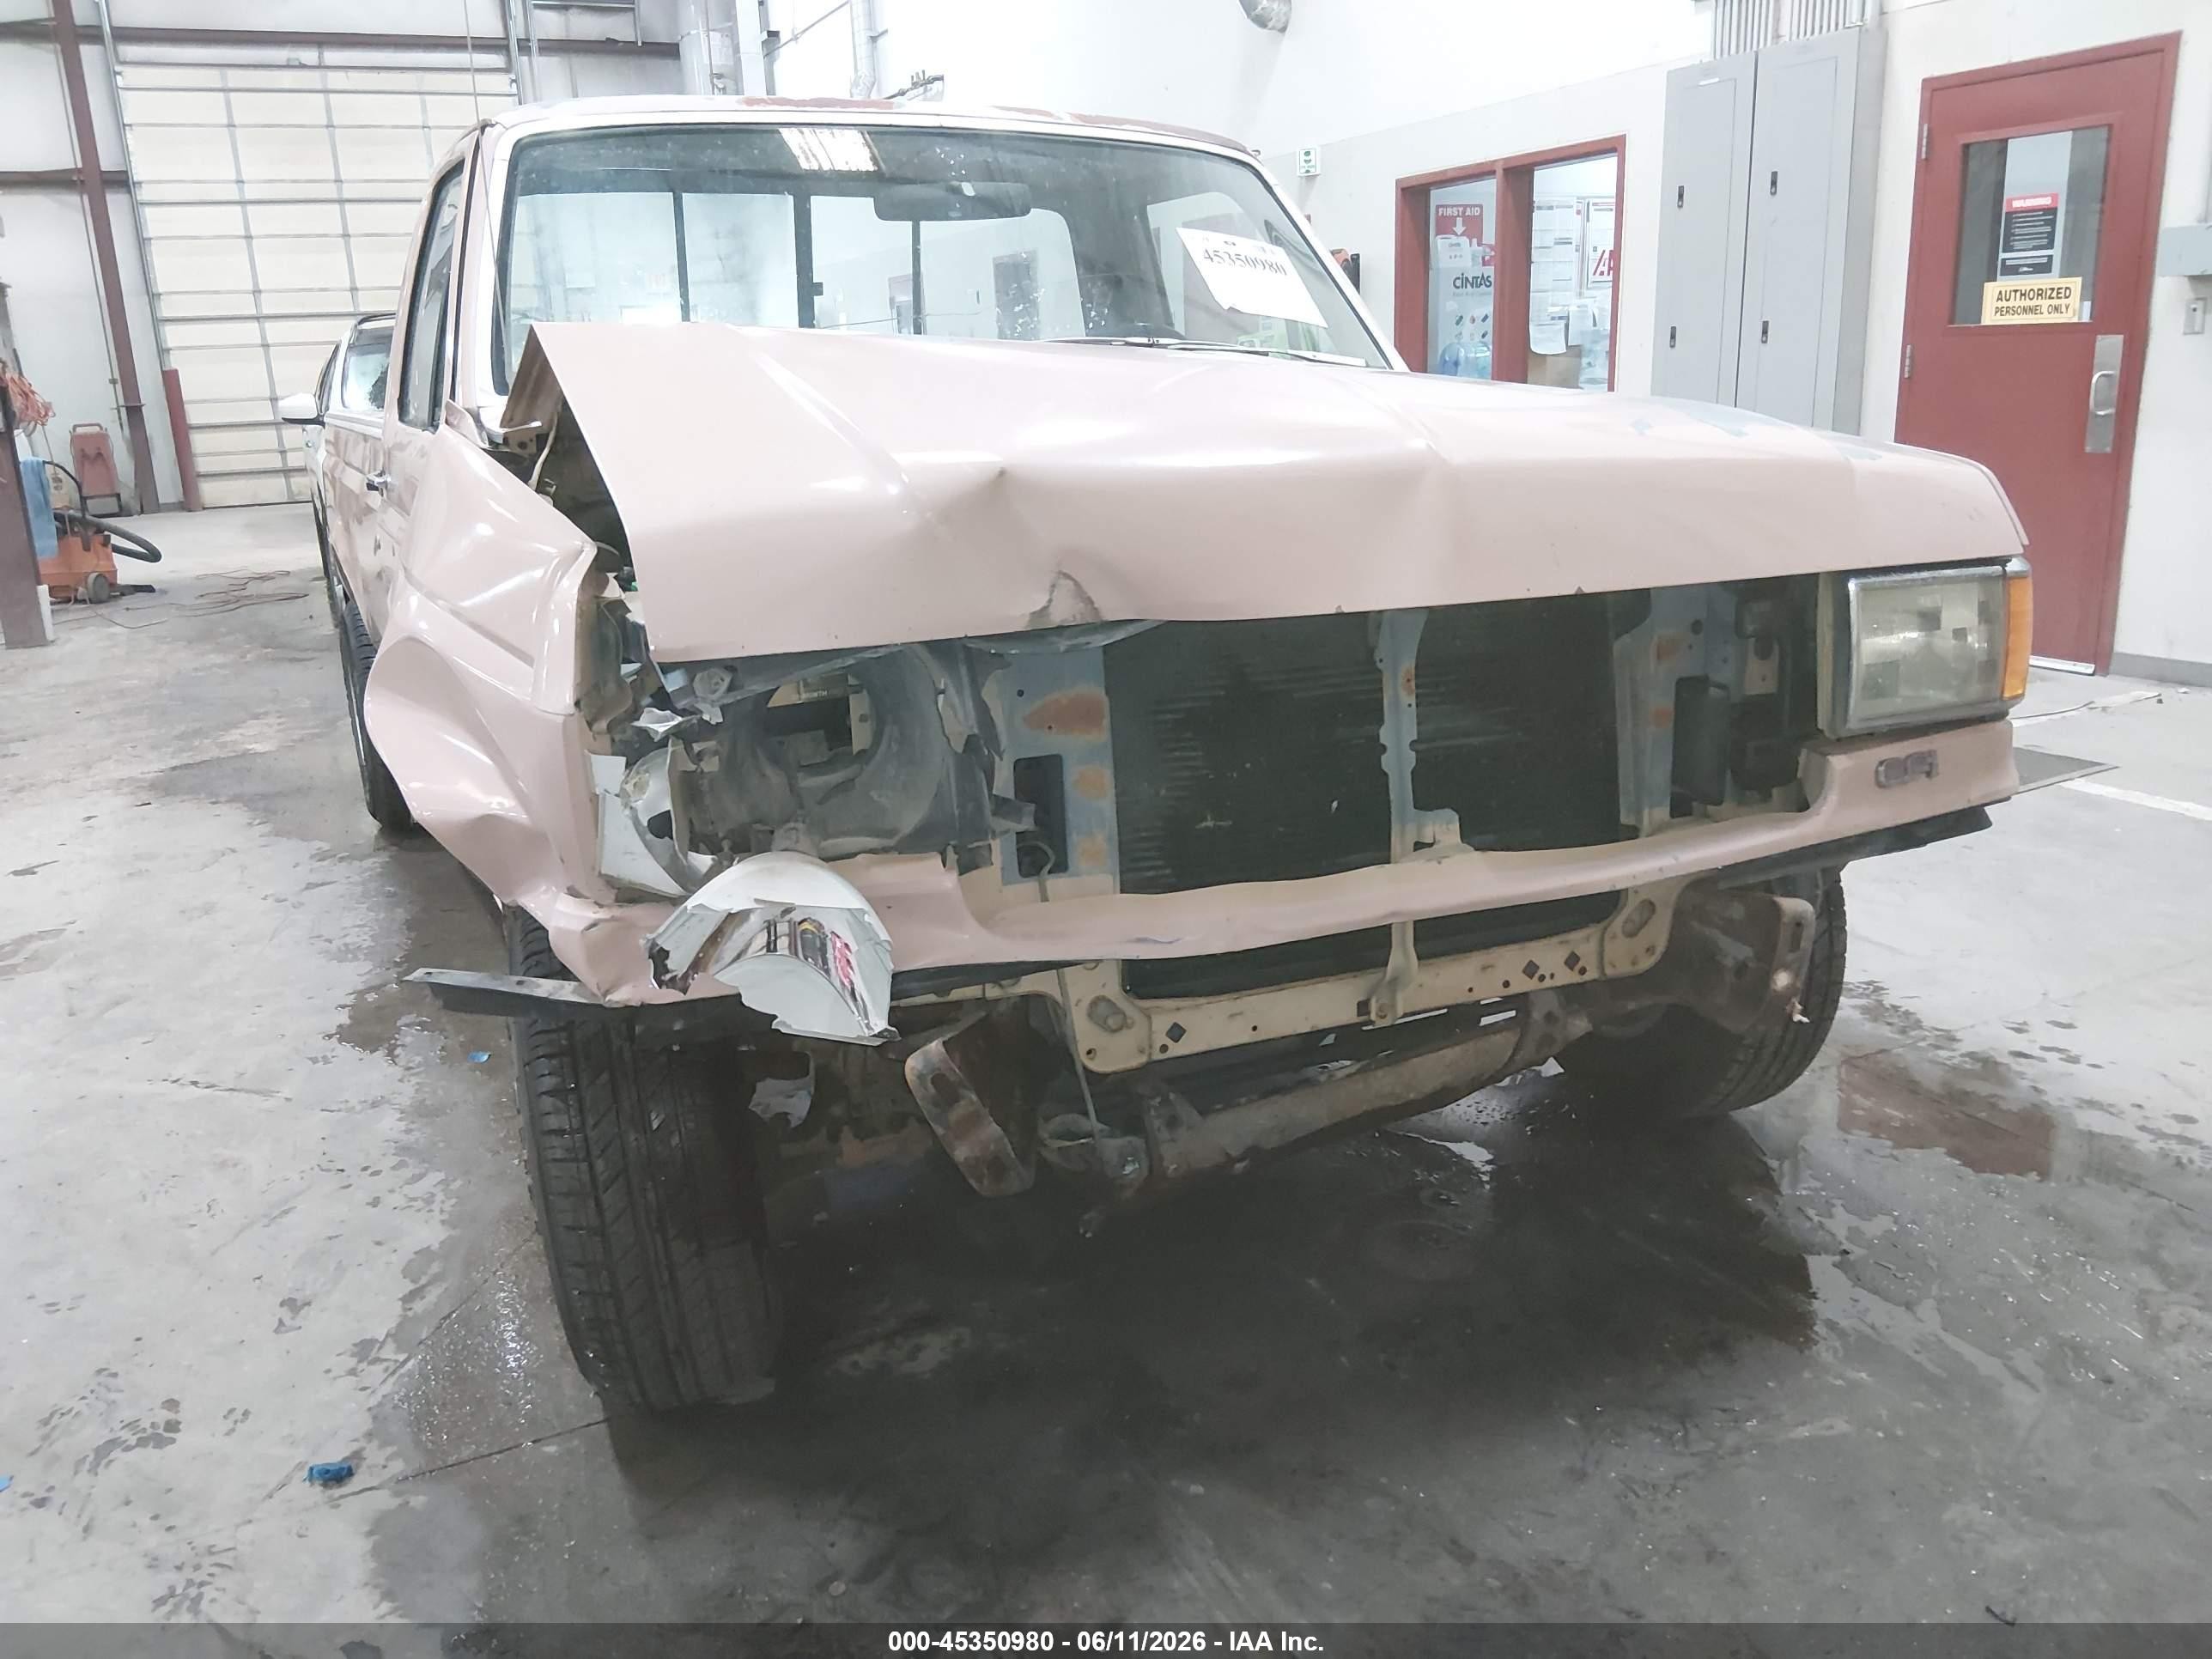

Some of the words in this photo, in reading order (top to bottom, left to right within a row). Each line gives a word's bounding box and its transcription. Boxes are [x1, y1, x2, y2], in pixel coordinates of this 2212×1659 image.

[1438, 207, 1463, 216] FIRST
[1465, 207, 1480, 216] AID
[1996, 287, 2072, 302] AUTHORIZED
[1995, 304, 2044, 316] PERSONNEL
[2047, 303, 2070, 314] ONLY
